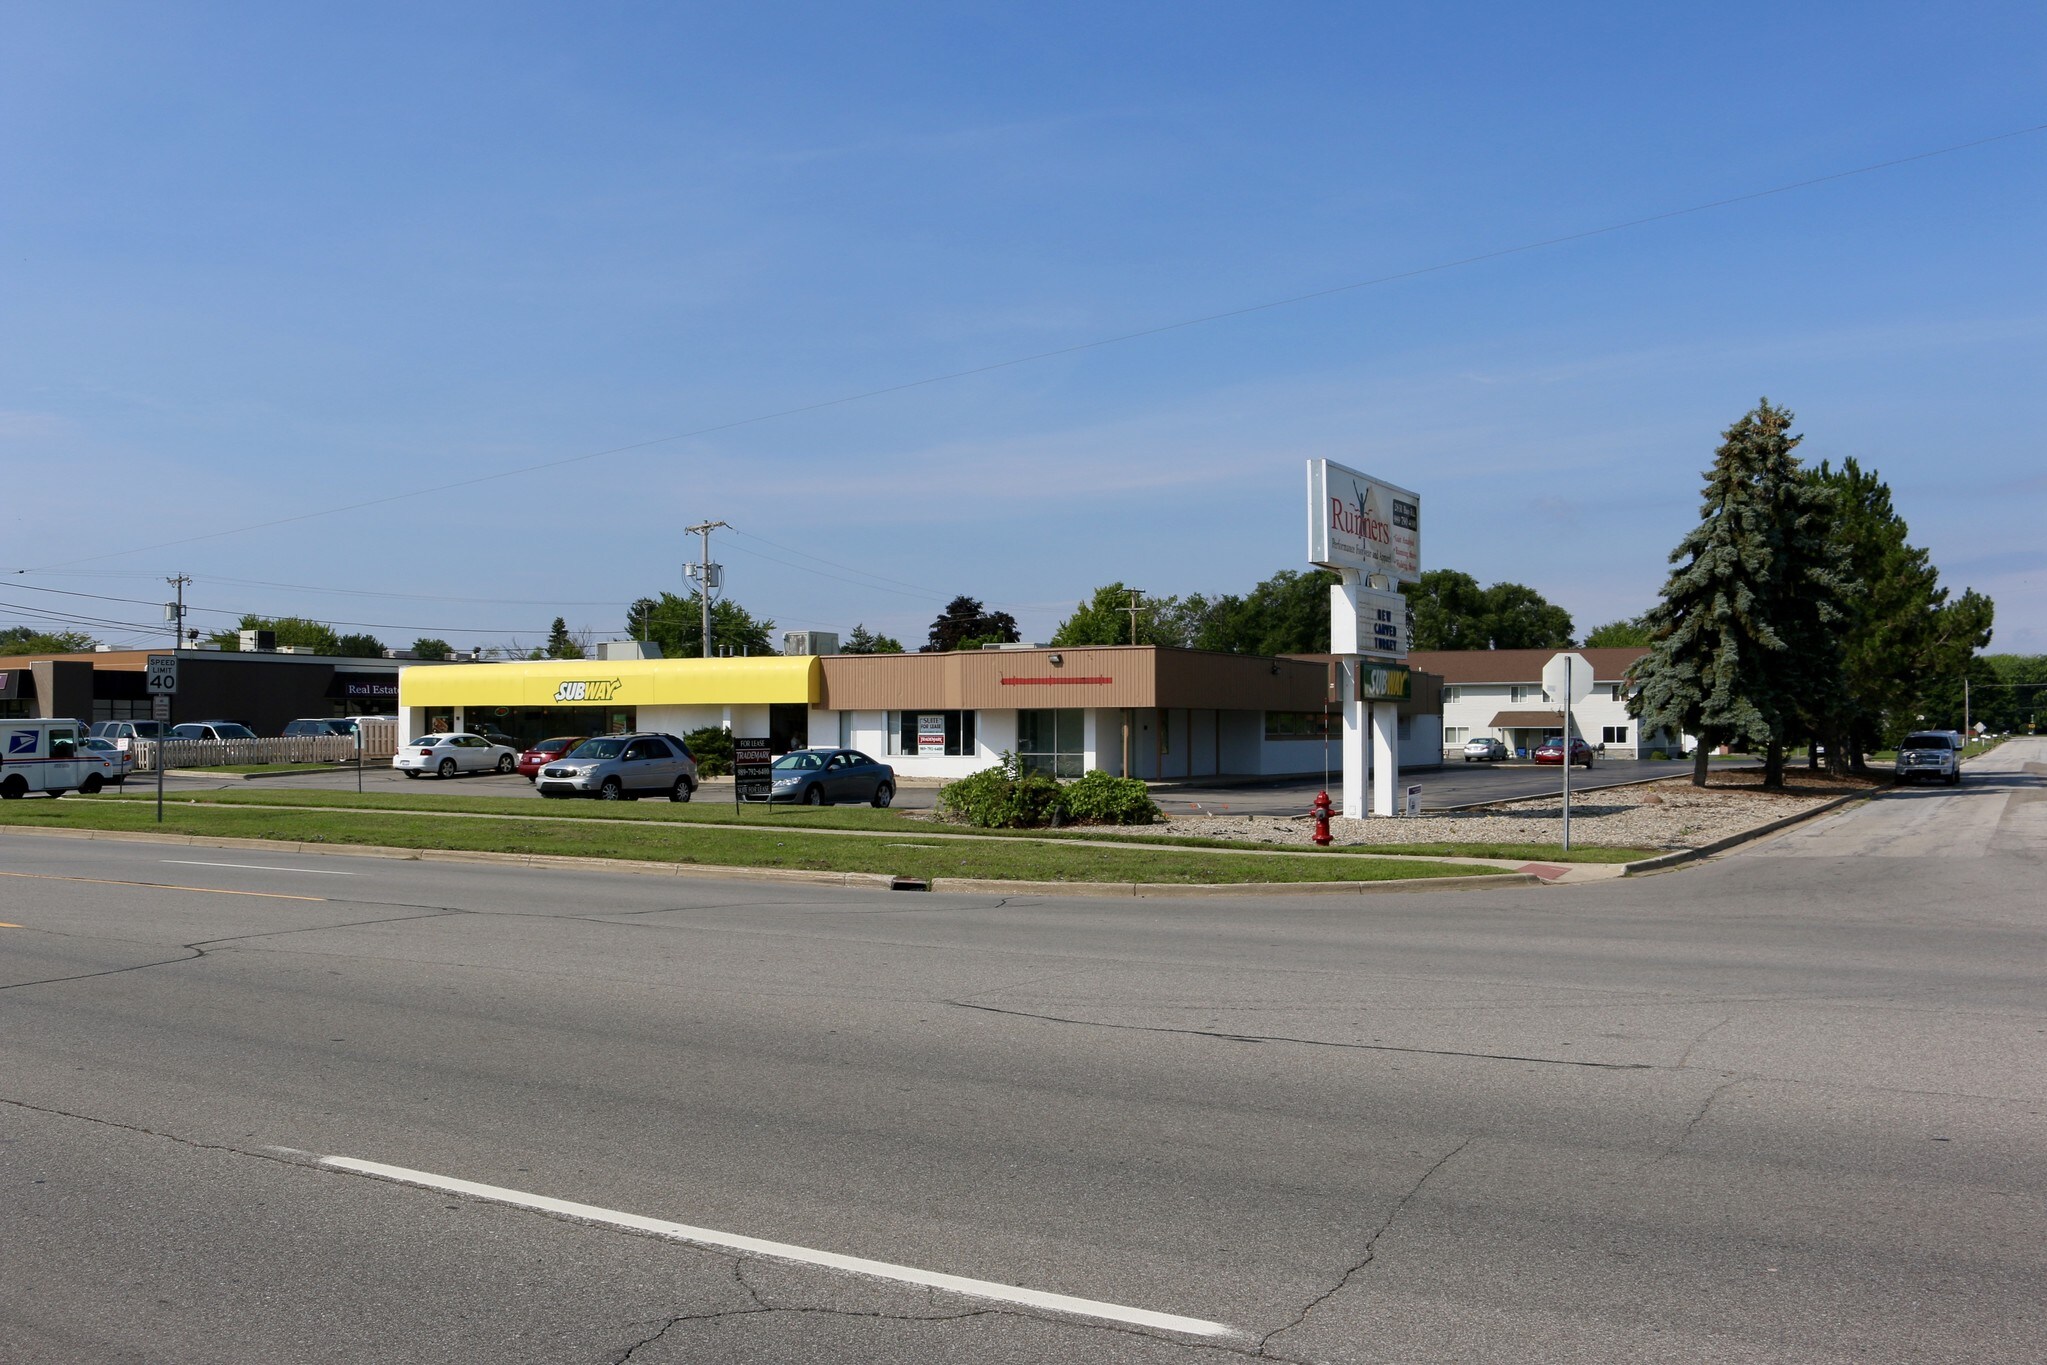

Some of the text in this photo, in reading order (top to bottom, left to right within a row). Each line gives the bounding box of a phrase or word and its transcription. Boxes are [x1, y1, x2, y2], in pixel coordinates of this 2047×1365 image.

[1330, 497, 1390, 545] Runners
[1377, 609, 1392, 622] NEW
[1374, 623, 1397, 637] CARVED
[1374, 637, 1397, 651] TURKEY
[150, 675, 175, 689] 40
[348, 684, 370, 694] Real
[1369, 669, 1408, 696] SUBWAY
[554, 678, 622, 703] SUBWAY
[735, 751, 770, 762] TRADEMARK
